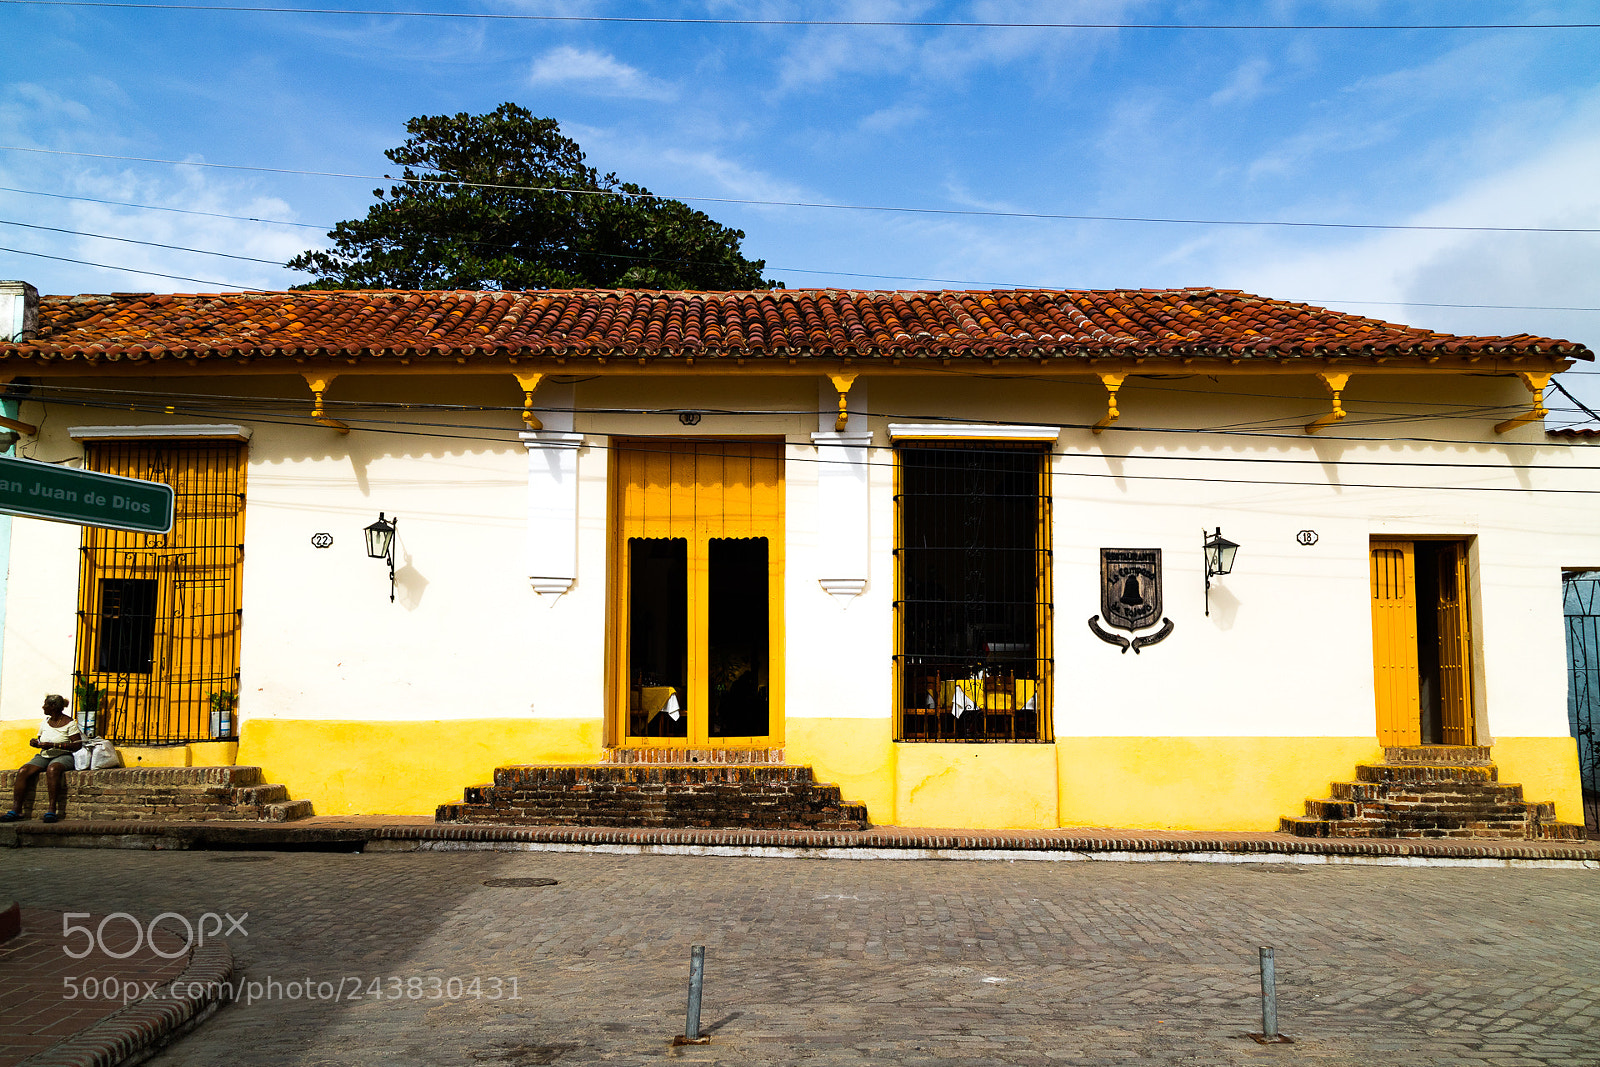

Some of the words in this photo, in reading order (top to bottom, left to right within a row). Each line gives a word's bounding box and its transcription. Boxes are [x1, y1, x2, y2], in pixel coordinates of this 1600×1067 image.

[0, 479, 22, 493] an
[29, 482, 77, 502] Juan
[84, 492, 107, 506] de
[112, 495, 151, 514] Dios
[316, 535, 328, 546] 22
[1303, 532, 1312, 542] 18
